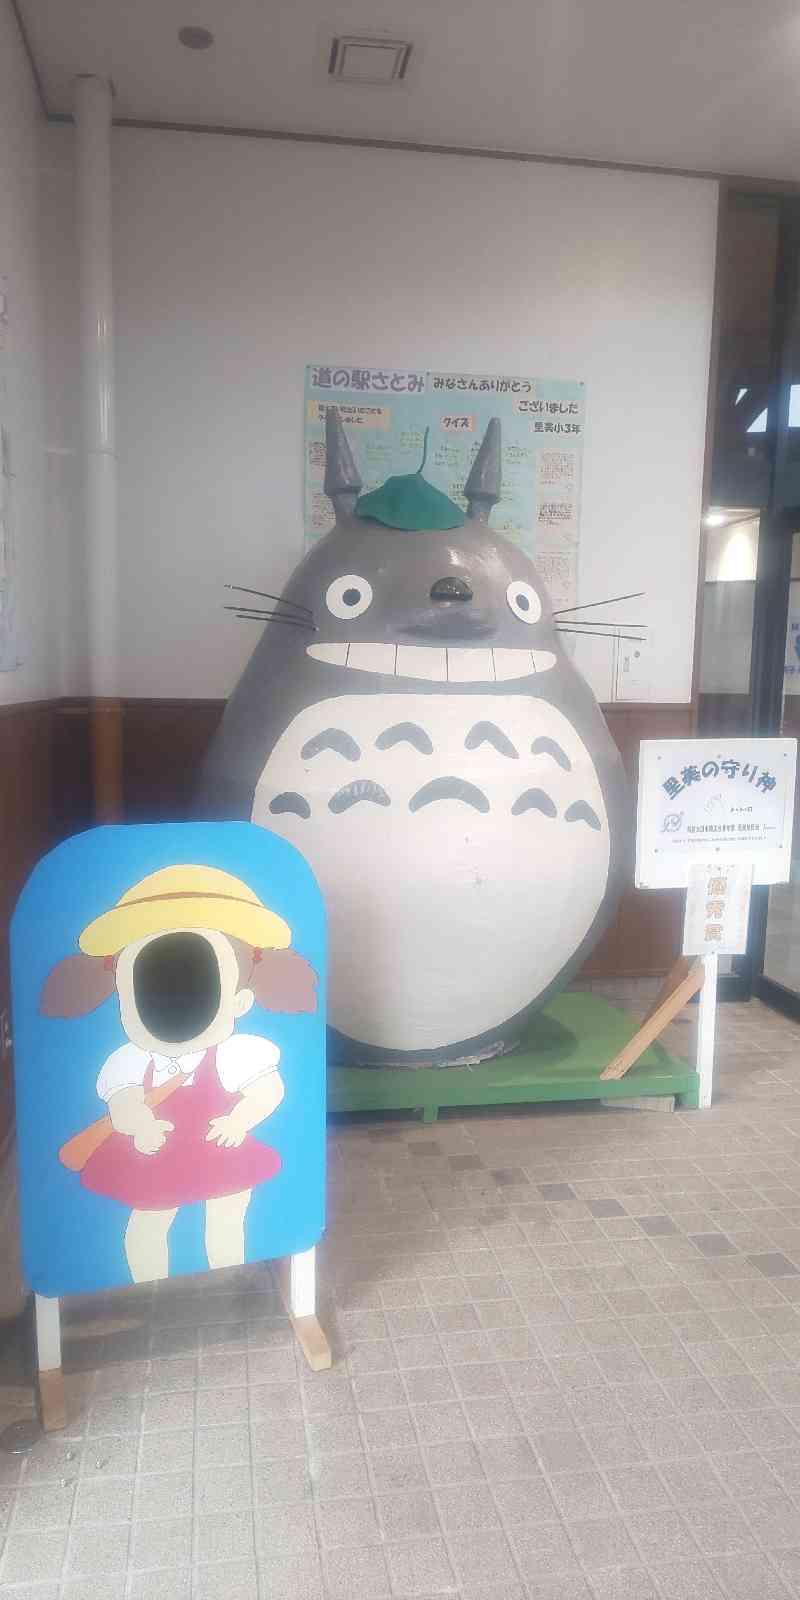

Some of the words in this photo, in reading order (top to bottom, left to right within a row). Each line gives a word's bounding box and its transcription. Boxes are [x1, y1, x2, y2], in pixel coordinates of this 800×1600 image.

[311, 367, 425, 392] 道の駅さとみ
[433, 376, 533, 393] みなさんありがとう
[518, 400, 579, 414] ございました
[662, 759, 777, 800] 里美の守り神
